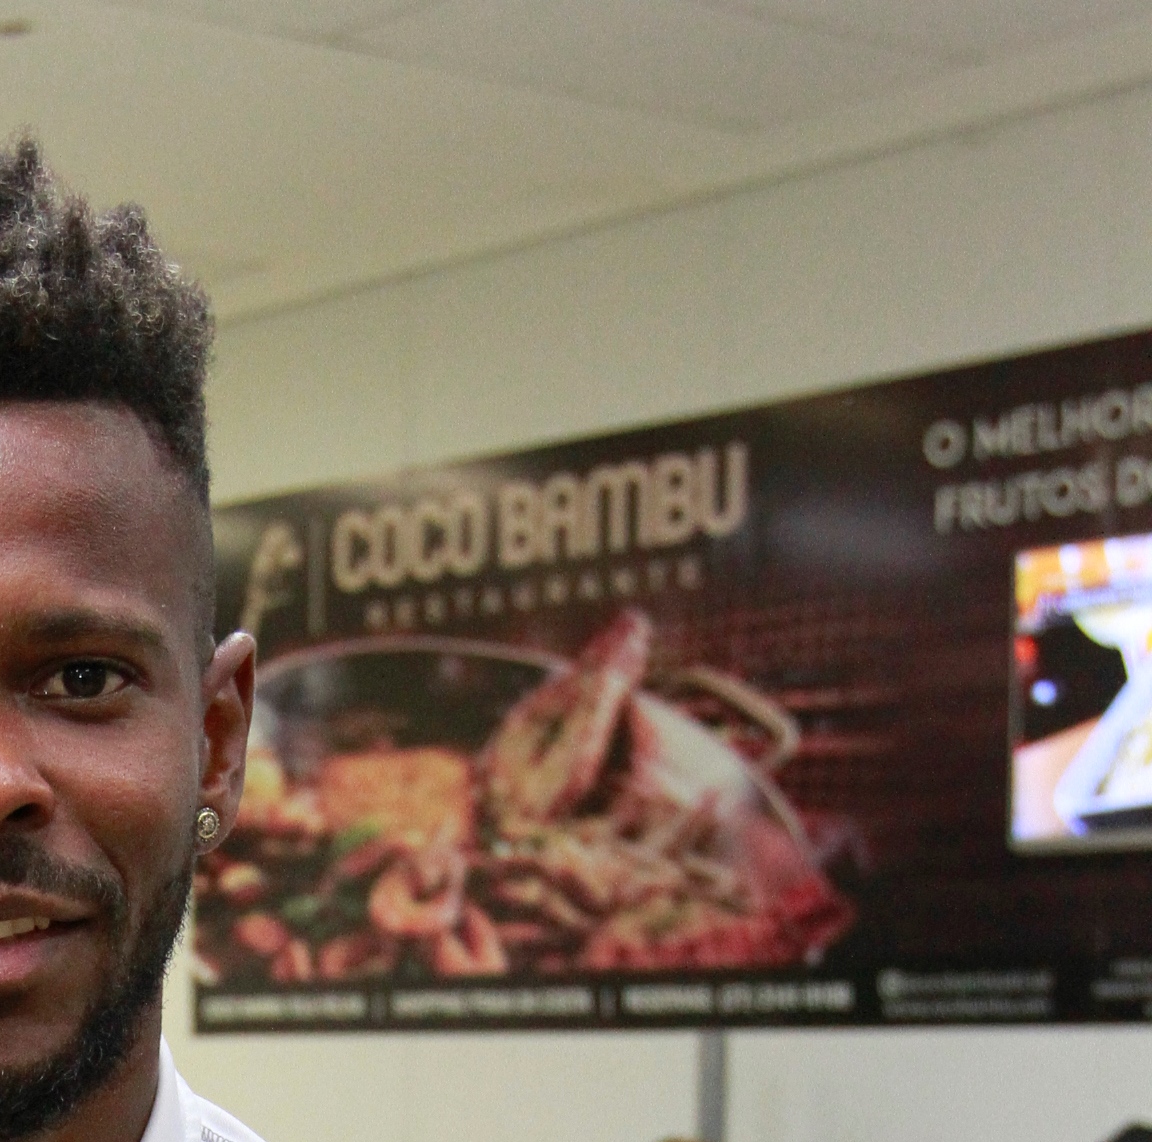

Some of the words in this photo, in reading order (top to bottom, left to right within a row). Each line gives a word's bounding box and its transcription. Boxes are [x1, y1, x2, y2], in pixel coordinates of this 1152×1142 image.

[923, 418, 967, 468] O
[332, 492, 486, 592] COCO
[498, 442, 747, 570] BAMBU
[934, 462, 1108, 536] FRUTOS
[1115, 455, 1152, 508] D
